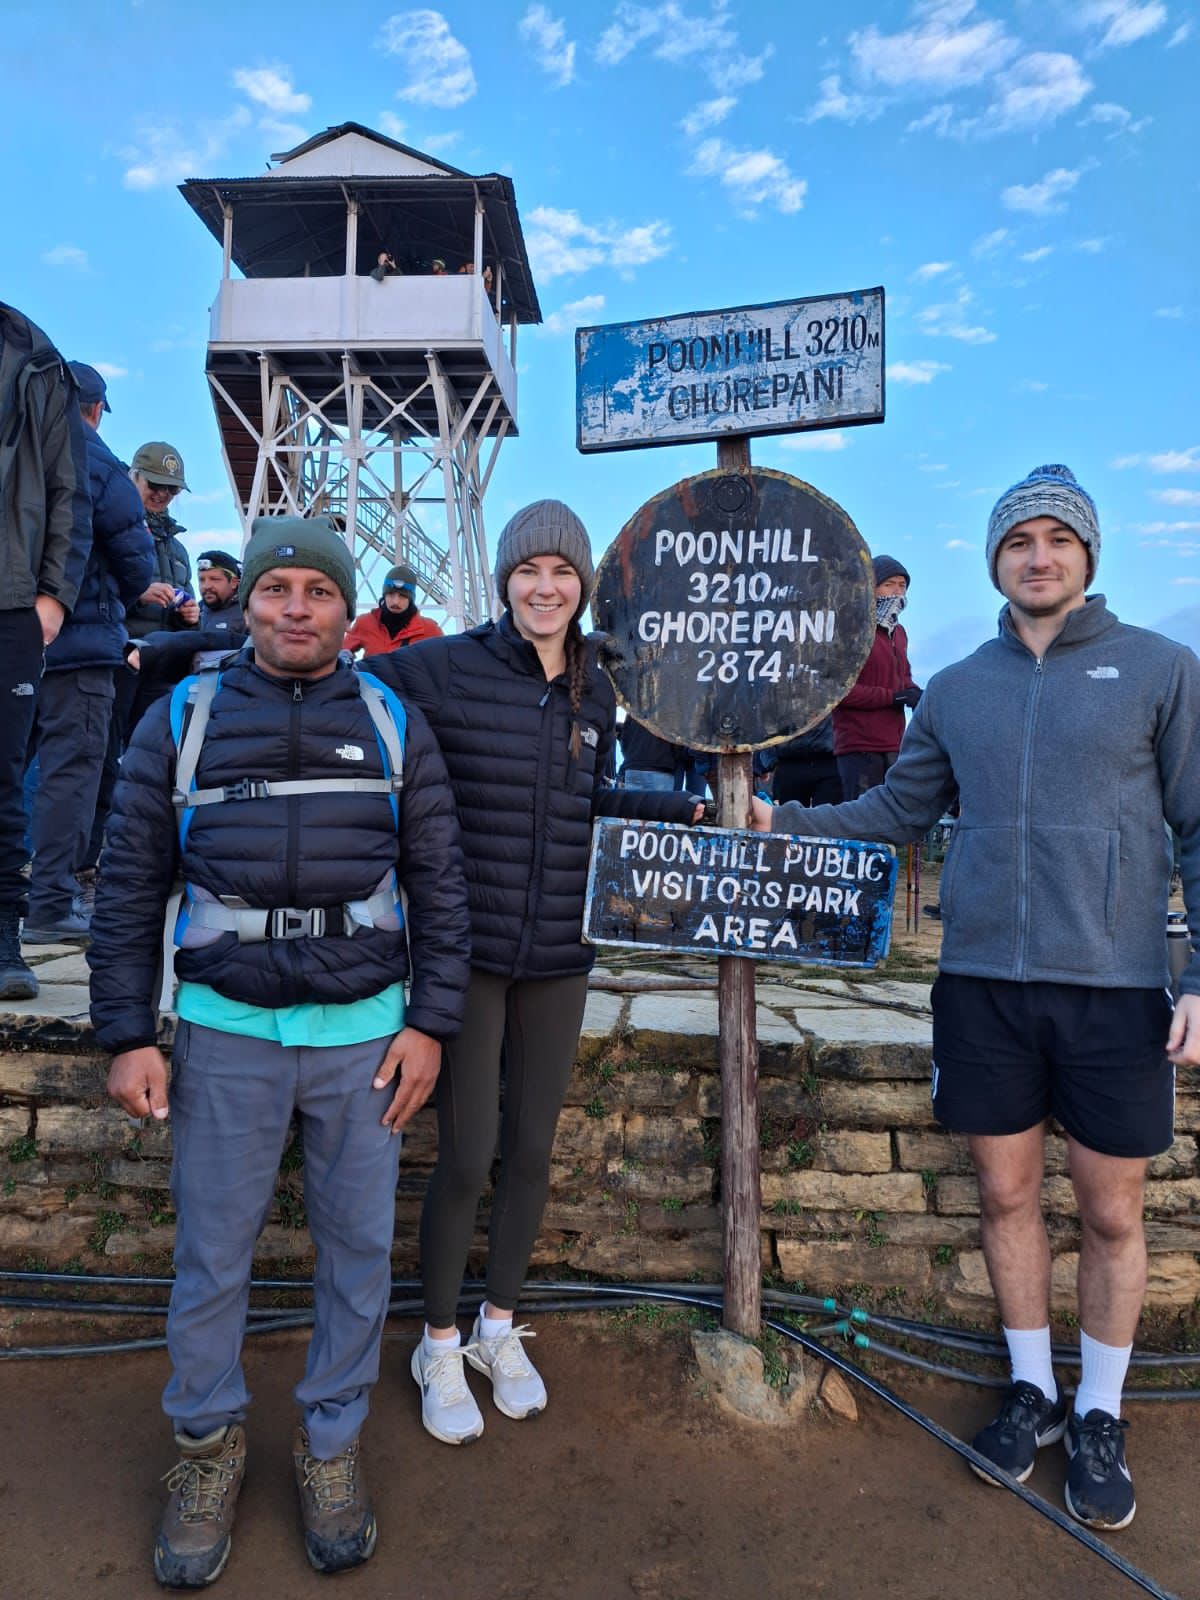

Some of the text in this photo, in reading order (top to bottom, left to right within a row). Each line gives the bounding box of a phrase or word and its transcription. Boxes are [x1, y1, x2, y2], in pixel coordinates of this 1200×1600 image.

[649, 328, 800, 376] POONHILL
[668, 366, 843, 421] GHOREPANI
[655, 528, 818, 566] POONHILL
[638, 610, 835, 648] GHOREPANI
[696, 650, 781, 683] 2874
[620, 830, 886, 881] POONHILL PUBLIC
[632, 869, 863, 916] VISITORS PARK
[693, 915, 798, 949] AREA
